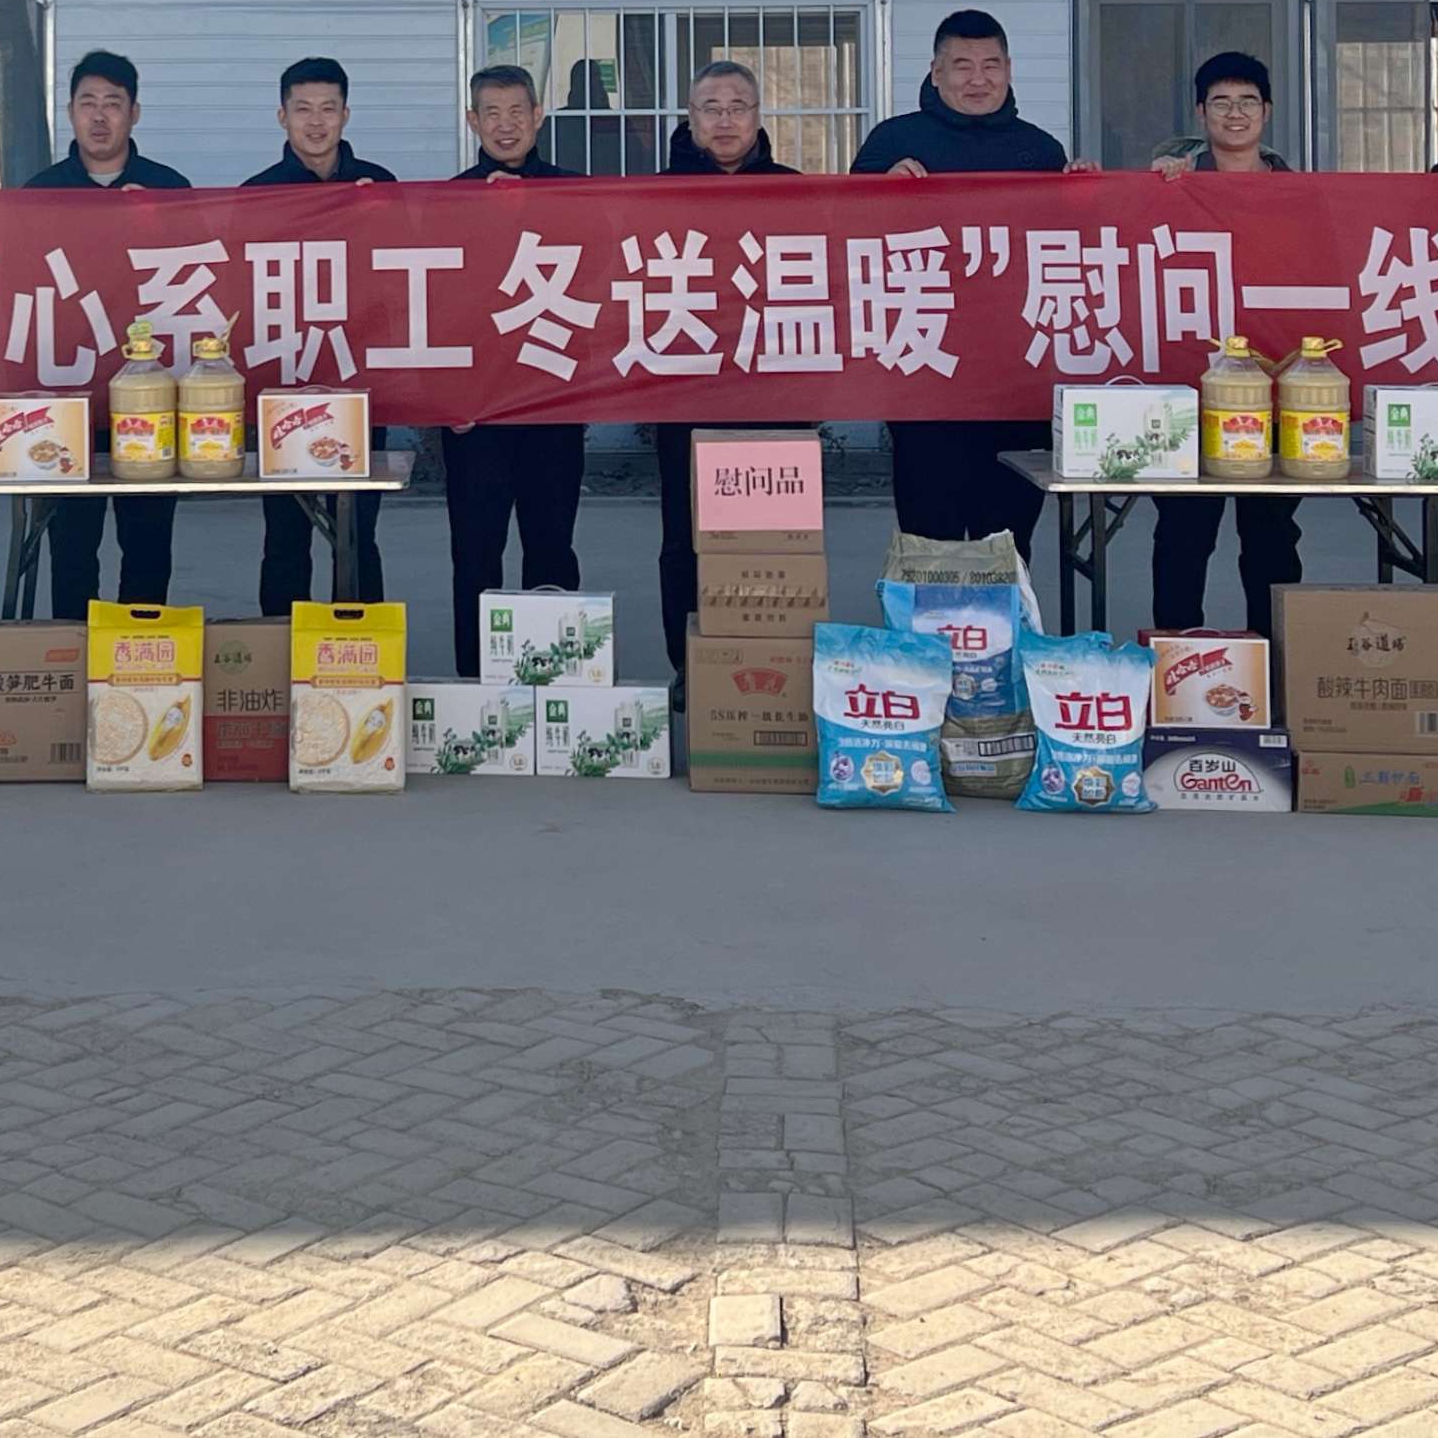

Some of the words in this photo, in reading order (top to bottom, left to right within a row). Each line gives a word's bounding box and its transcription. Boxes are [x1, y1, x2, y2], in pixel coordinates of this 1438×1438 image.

[714, 466, 804, 496] 慰问品
[114, 641, 175, 663] 香满园
[317, 643, 378, 665] 香满园
[1317, 676, 1408, 700] 酸辣牛肉面
[217, 689, 284, 712] 非油炸
[843, 683, 921, 720] 立白
[1055, 692, 1133, 731] 立白
[1189, 759, 1236, 773] 百岁山
